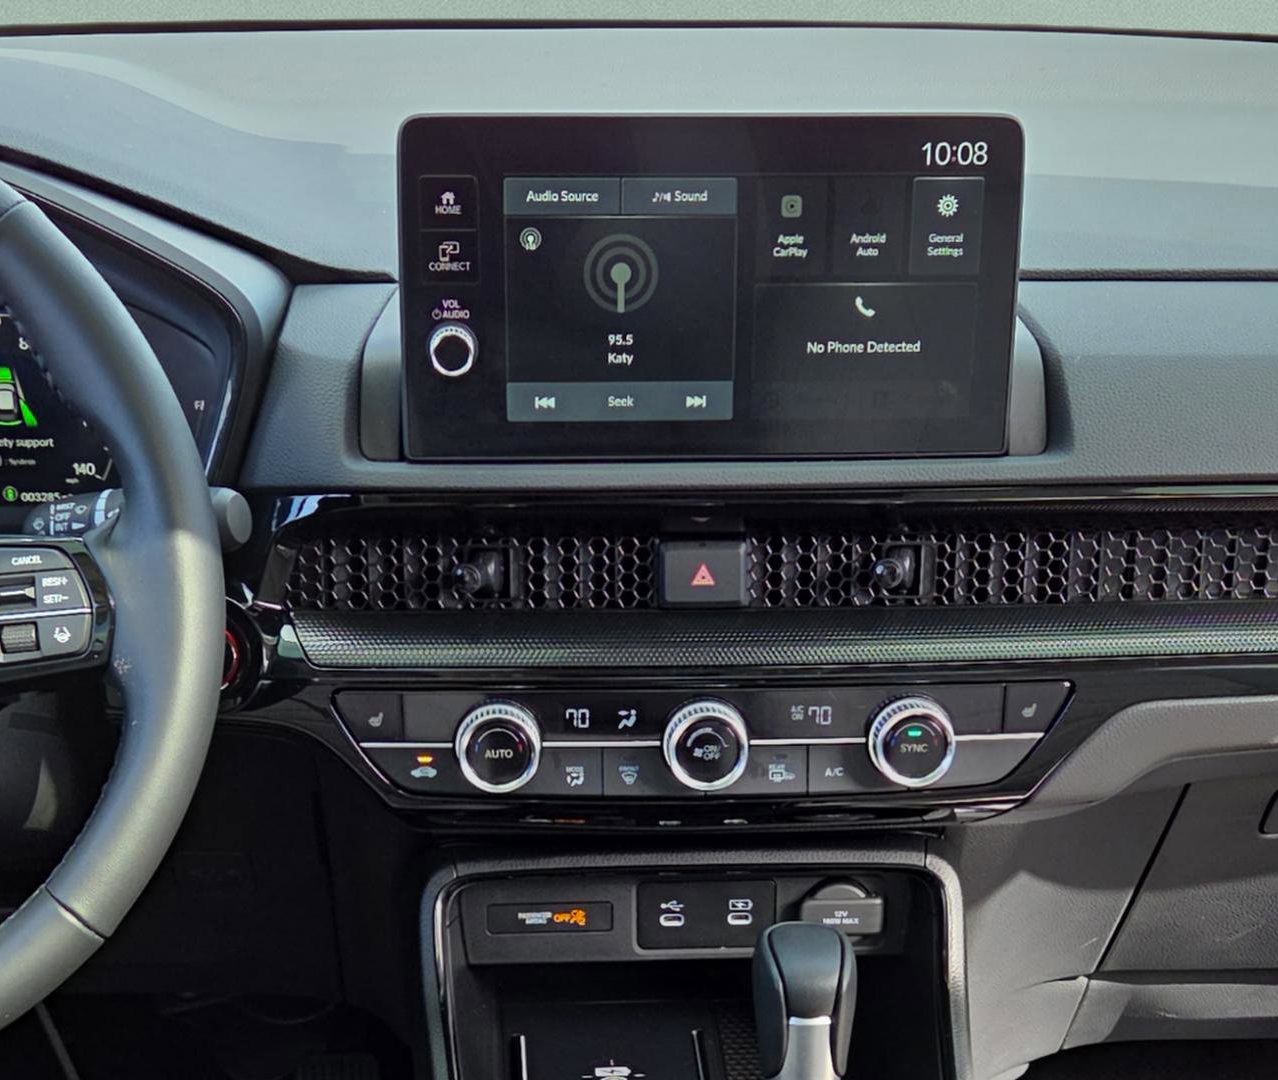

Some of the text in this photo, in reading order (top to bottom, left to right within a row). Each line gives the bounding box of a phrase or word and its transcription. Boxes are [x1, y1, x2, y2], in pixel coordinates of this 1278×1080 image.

[921, 141, 988, 165] 10:08
[526, 190, 599, 202] Audio Source
[674, 190, 708, 202] Sound
[435, 205, 462, 215] HOME
[777, 234, 804, 245] Apple
[850, 233, 886, 244] Android
[928, 233, 963, 243] General
[773, 247, 808, 258] CarPlay
[856, 247, 879, 257] Auto
[927, 247, 963, 258] Settings
[428, 262, 471, 271] CONNECT
[442, 299, 461, 309] VOL
[442, 310, 470, 319] AUDIO
[607, 333, 634, 347] 95.5
[807, 340, 921, 353] No Phone Detected
[608, 352, 633, 366] Katy
[608, 395, 633, 407] Seek
[16, 437, 55, 448] support
[73, 462, 96, 476] 140
[11, 555, 43, 566] CANCEL
[566, 708, 590, 728] 70
[808, 706, 832, 725] 70
[484, 749, 514, 759] AUTO
[900, 744, 929, 753] SYNC
[825, 767, 844, 777] A/C
[553, 913, 571, 923] OFF
